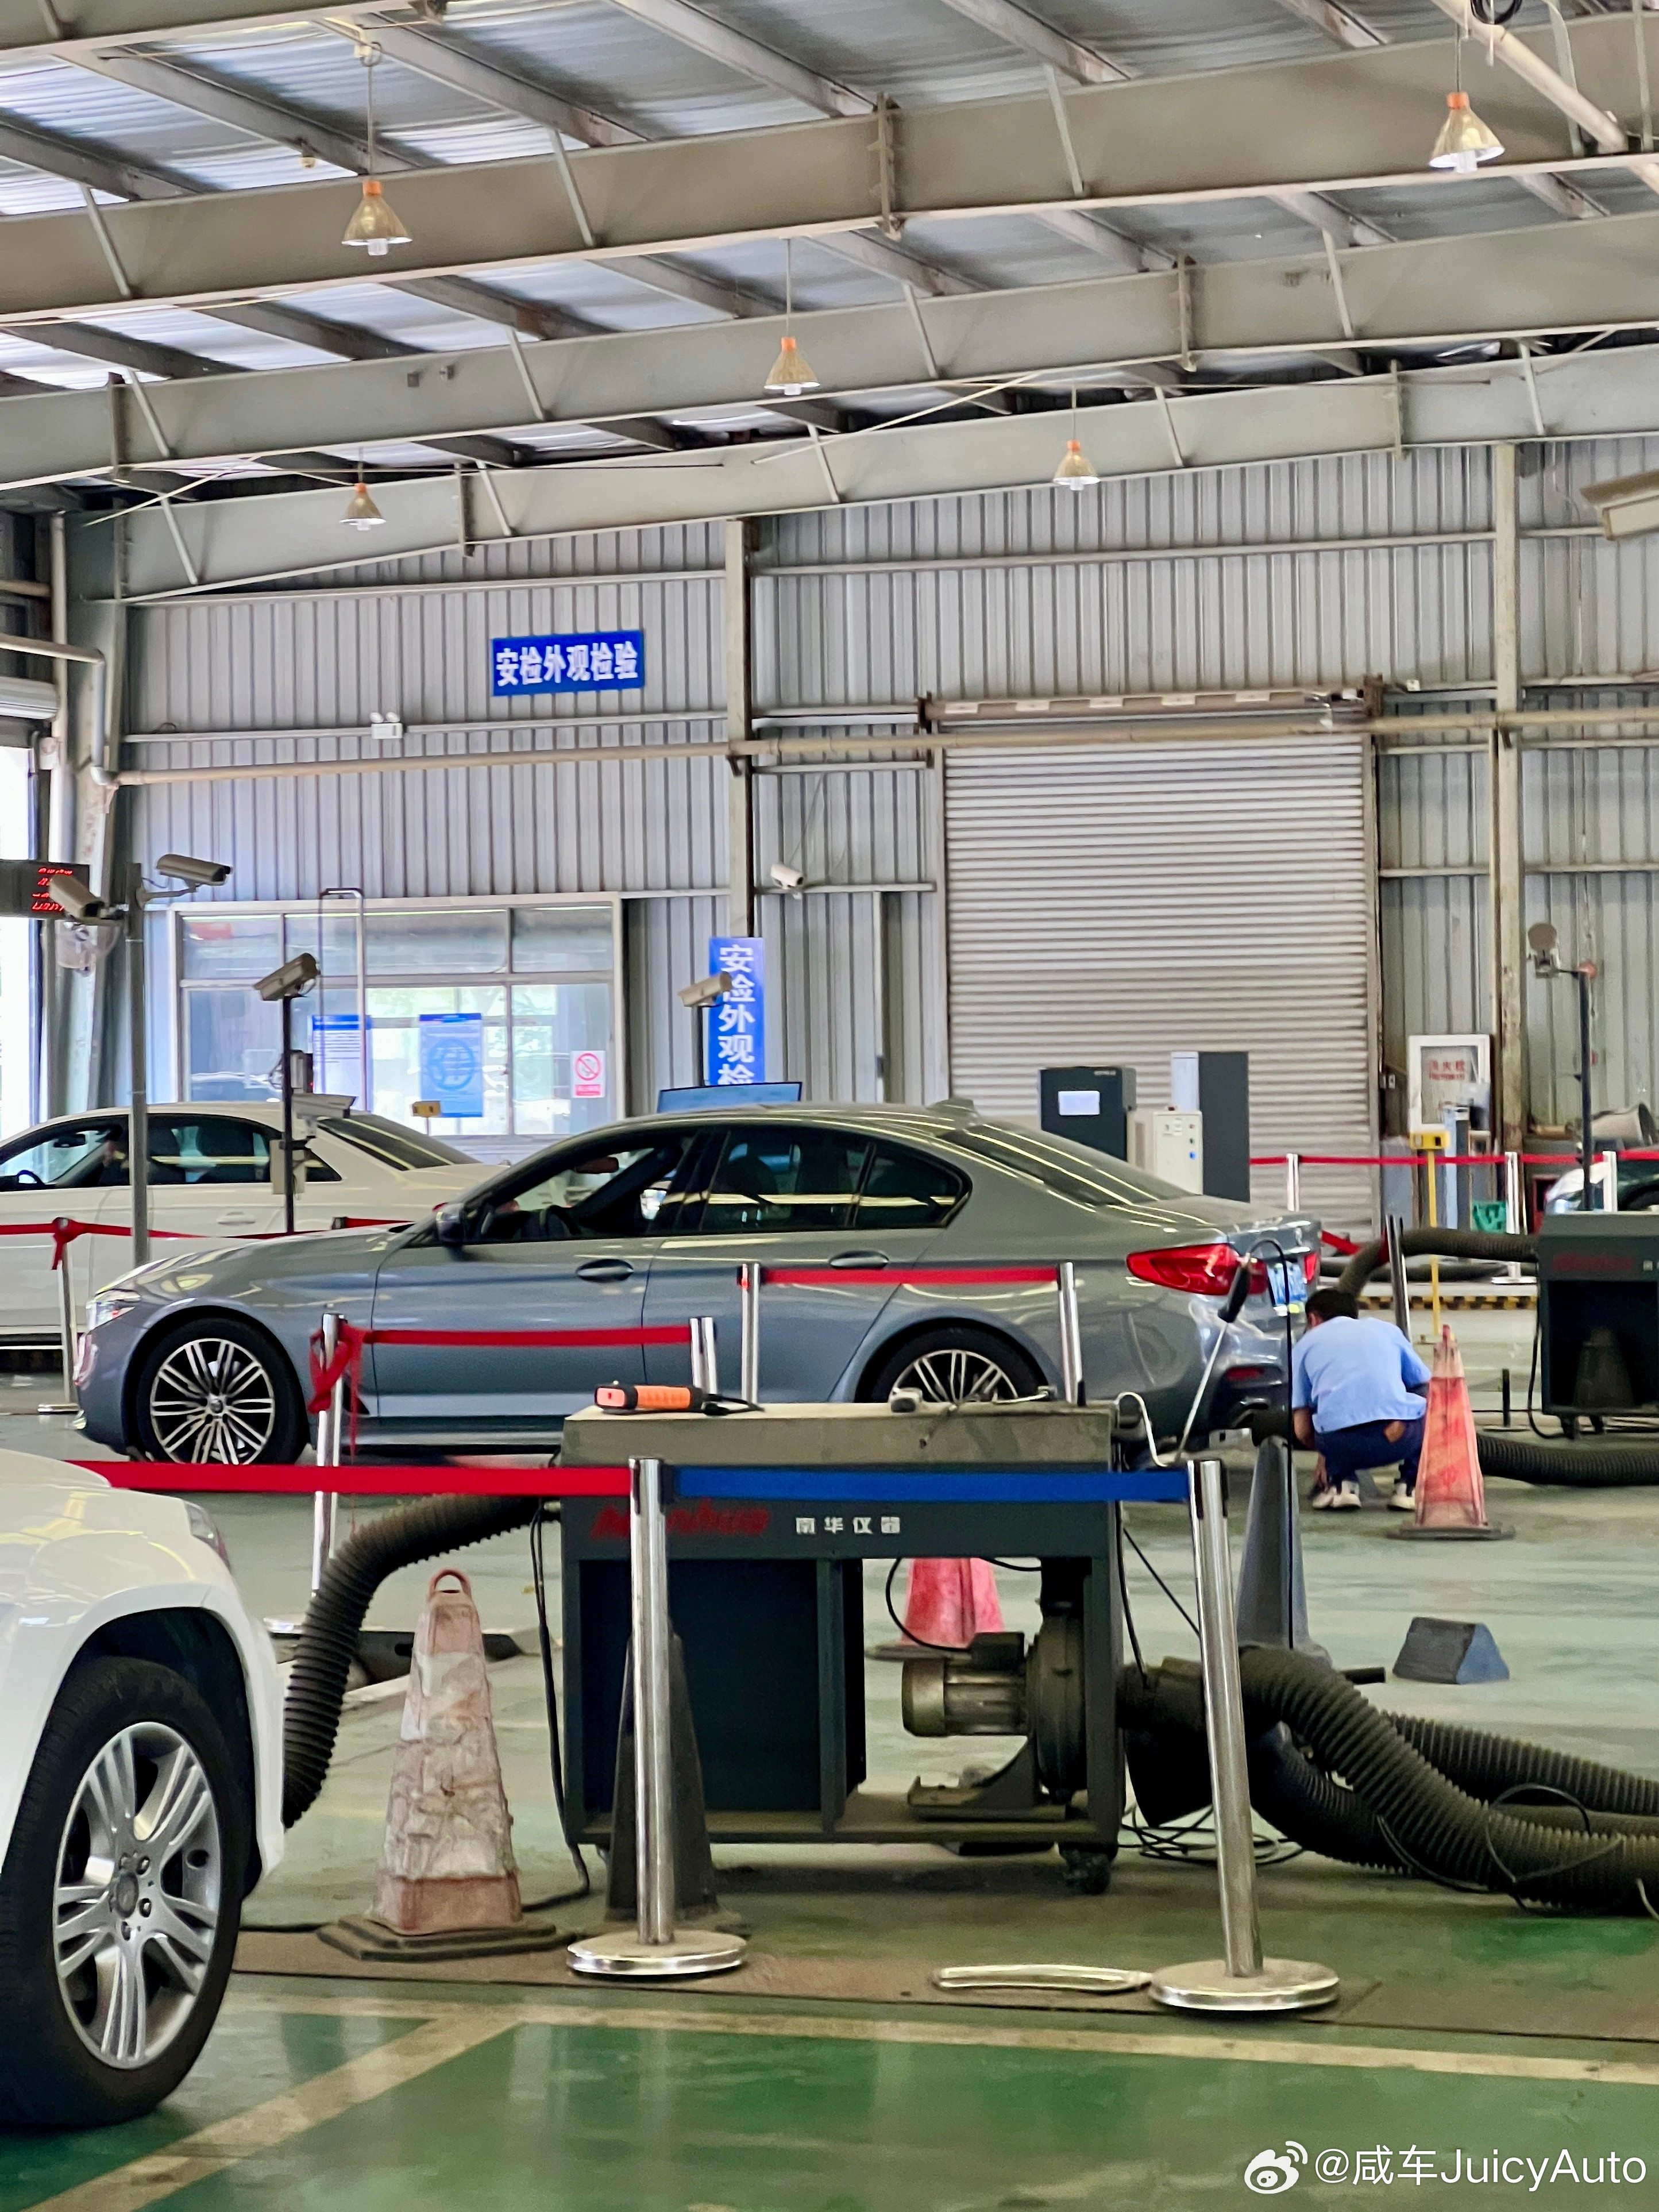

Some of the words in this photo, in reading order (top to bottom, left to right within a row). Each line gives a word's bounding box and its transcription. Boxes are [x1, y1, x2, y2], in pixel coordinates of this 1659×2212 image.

[496, 641, 638, 686] 安检外观检验
